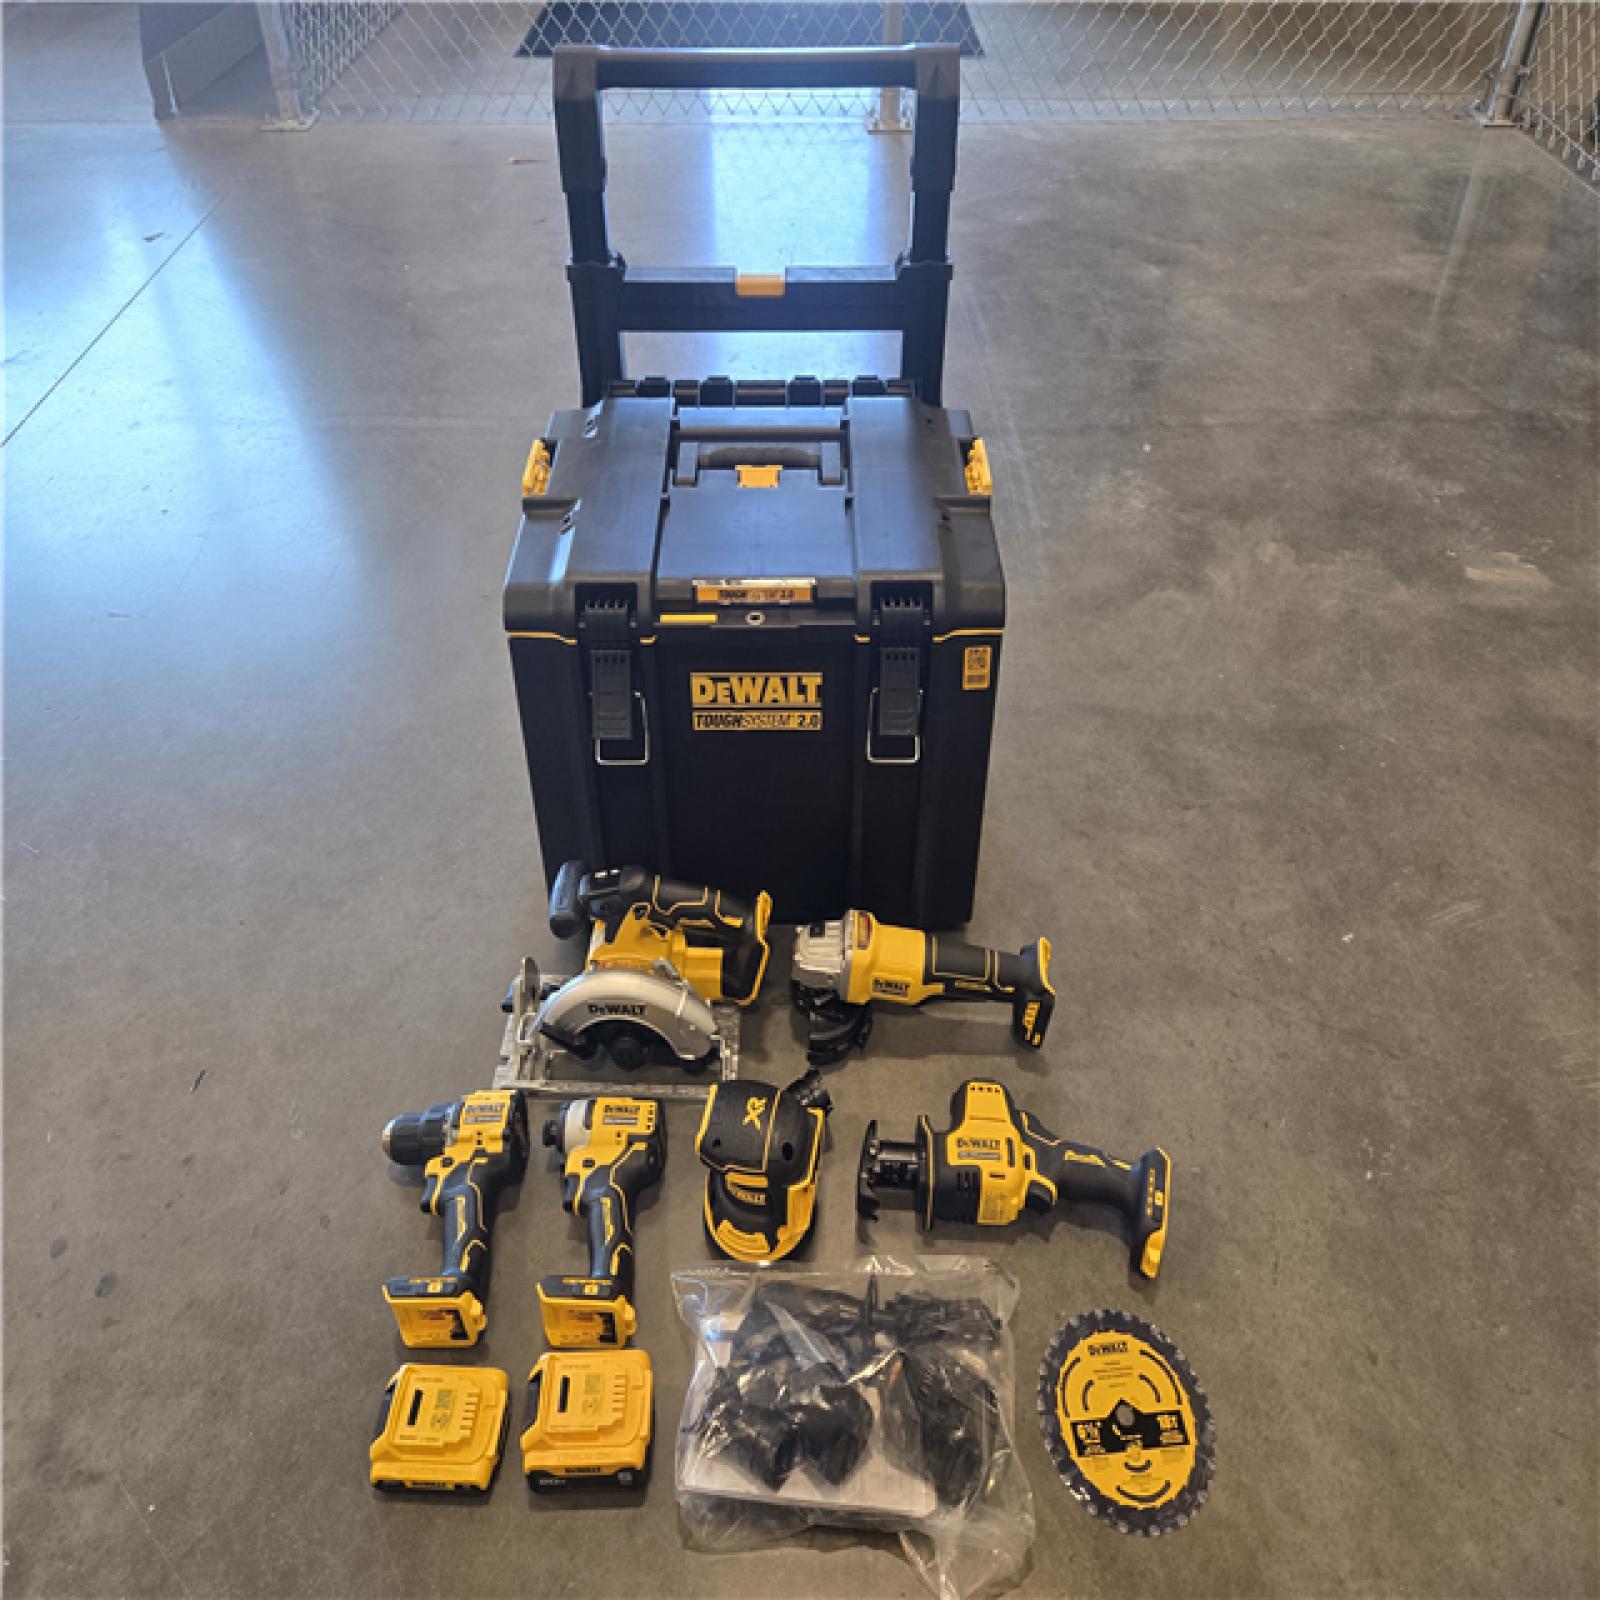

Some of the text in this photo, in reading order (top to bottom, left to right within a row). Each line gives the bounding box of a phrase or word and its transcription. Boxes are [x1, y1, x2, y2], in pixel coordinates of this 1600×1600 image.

[691, 674, 822, 704] DEWALT
[587, 1004, 646, 1016] DEWALT
[603, 1104, 641, 1114] DEWALT
[956, 1138, 1001, 1149] DEWALT
[1087, 1340, 1129, 1356] DEWALT
